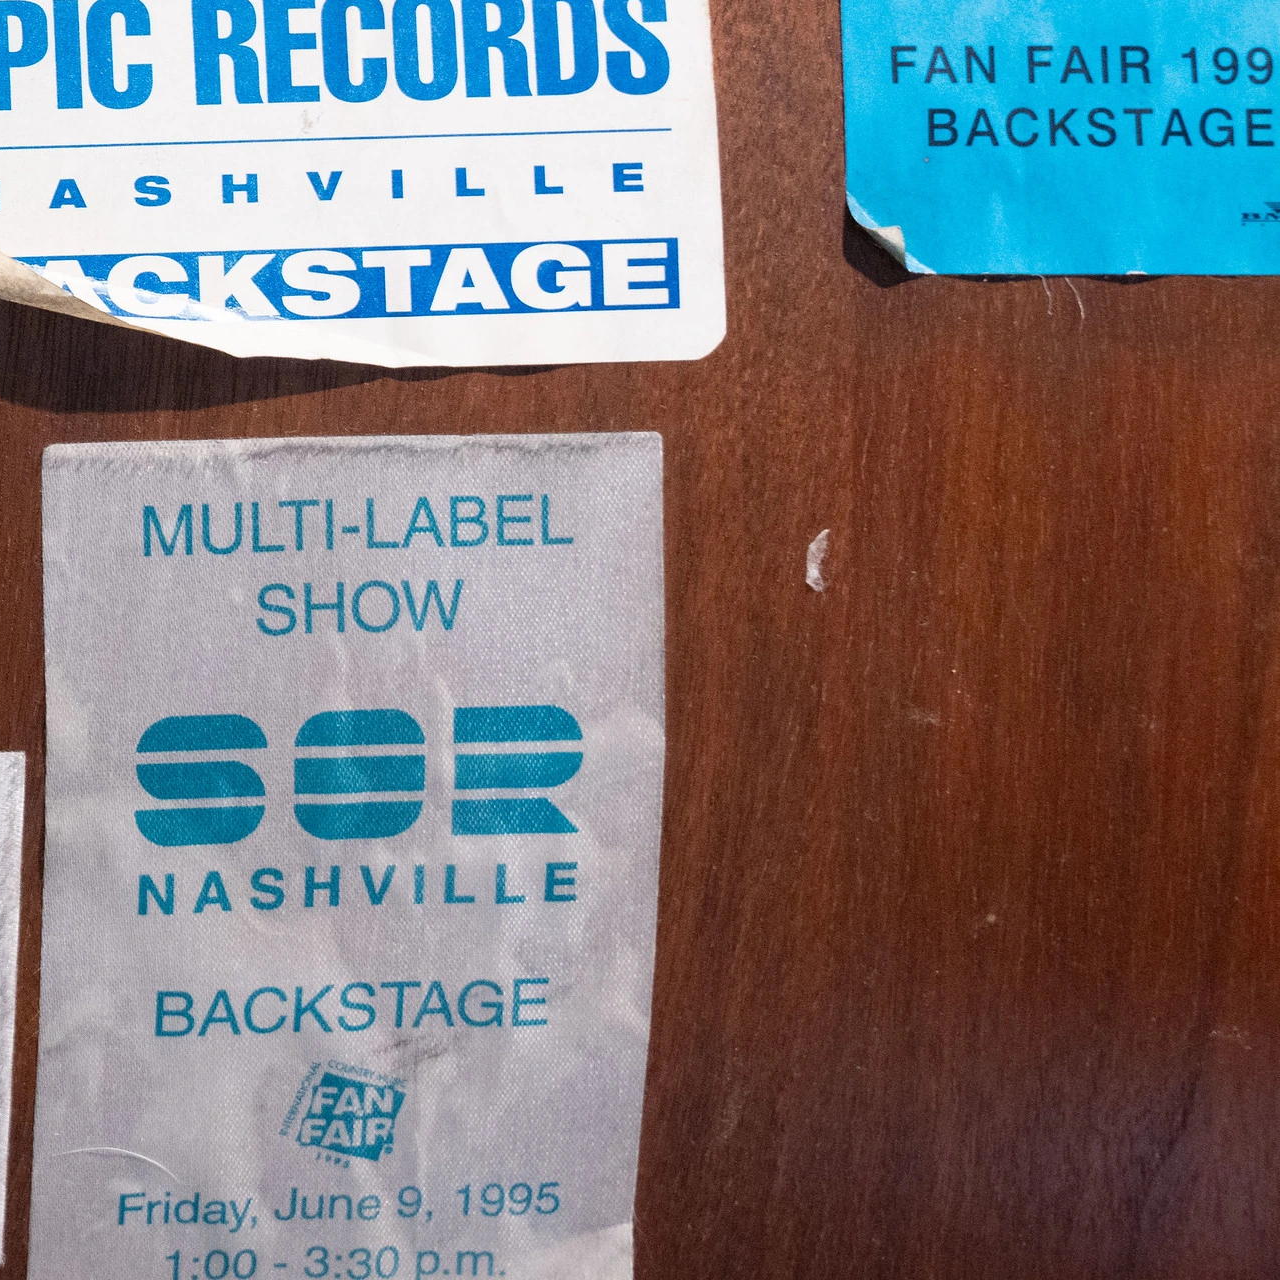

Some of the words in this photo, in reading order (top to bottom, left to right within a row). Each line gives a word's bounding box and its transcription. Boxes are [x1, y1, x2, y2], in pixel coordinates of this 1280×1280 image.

[890, 45, 996, 84] FAN
[1027, 45, 1152, 84] FAIR
[1181, 46, 1273, 85] 199
[928, 106, 1275, 148] BACKSTAGE
[38, 241, 669, 320] ACKSTAGE
[140, 492, 574, 558] MULTI-LABEL
[256, 578, 465, 637] SHOW
[135, 704, 584, 847] SOR
[138, 860, 579, 918] NASHVILLE
[155, 977, 550, 1037] BACKSTAGE
[311, 1086, 393, 1115] FAN
[300, 1118, 392, 1147] FAIR
[116, 1190, 259, 1234] Friday,
[274, 1187, 381, 1221] June
[397, 1185, 434, 1222] 9,
[457, 1181, 560, 1217] 1995
[165, 1248, 257, 1280] 1:00
[303, 1246, 400, 1280] 3:30
[416, 1250, 506, 1280] p.m.
